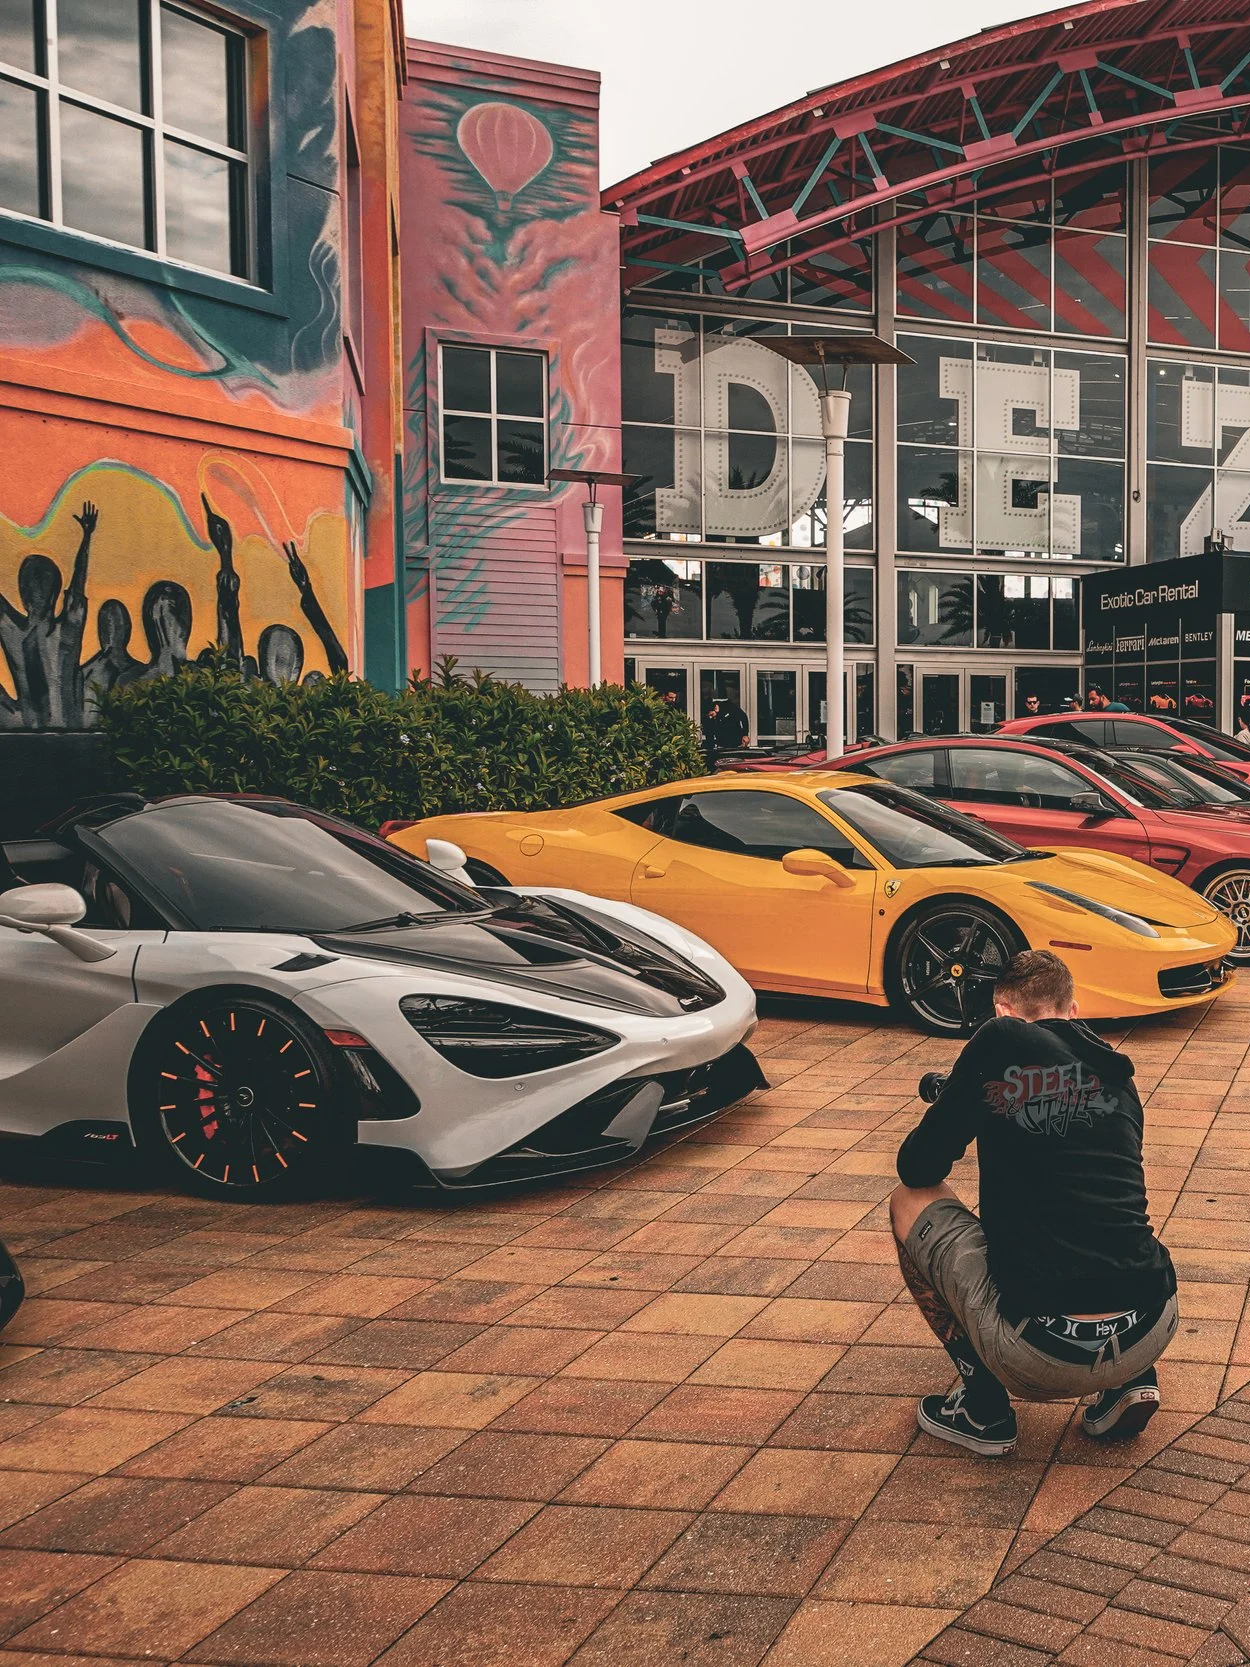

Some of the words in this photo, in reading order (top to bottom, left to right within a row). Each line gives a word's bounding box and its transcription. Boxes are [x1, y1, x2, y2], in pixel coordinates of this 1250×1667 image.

[1101, 592, 1134, 610] Exotic
[1135, 589, 1157, 606] Car
[1158, 580, 1199, 603] Rental
[1115, 635, 1144, 652] Ferrari
[1148, 636, 1179, 646] McLaren
[1184, 631, 1213, 642] BENTLEY
[1003, 1061, 1097, 1101] STEEL
[1007, 1096, 1021, 1116] &
[1022, 1087, 1104, 1137] STYLE
[1096, 1322, 1118, 1337] Hey
